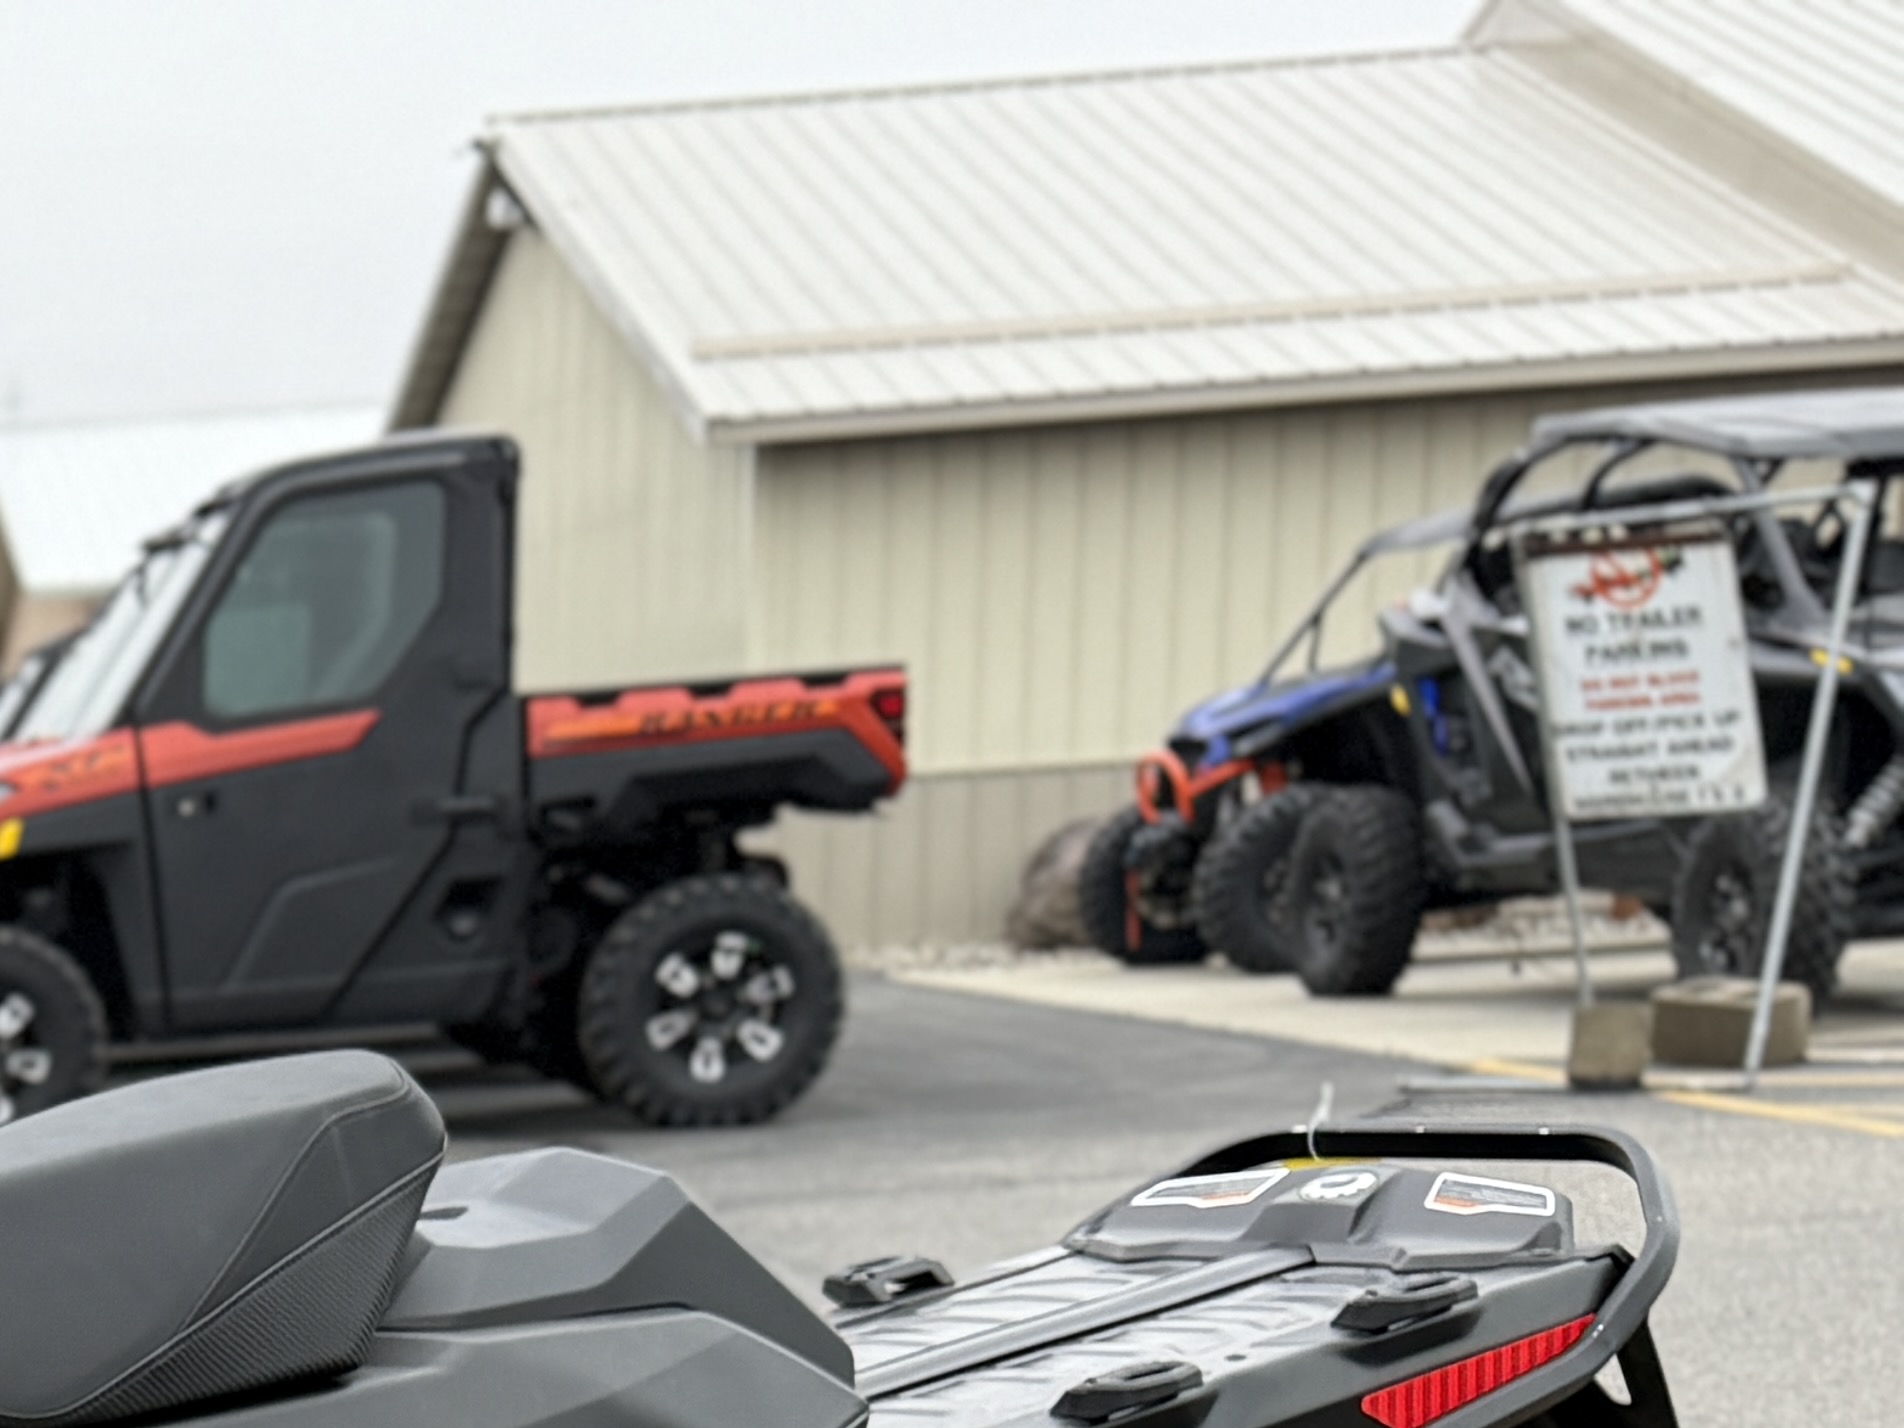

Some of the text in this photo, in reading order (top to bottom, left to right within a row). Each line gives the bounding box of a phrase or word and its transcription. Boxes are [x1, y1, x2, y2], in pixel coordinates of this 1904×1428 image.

[1565, 606, 1703, 636] NO TRAILER
[1585, 640, 1689, 664] PARKING
